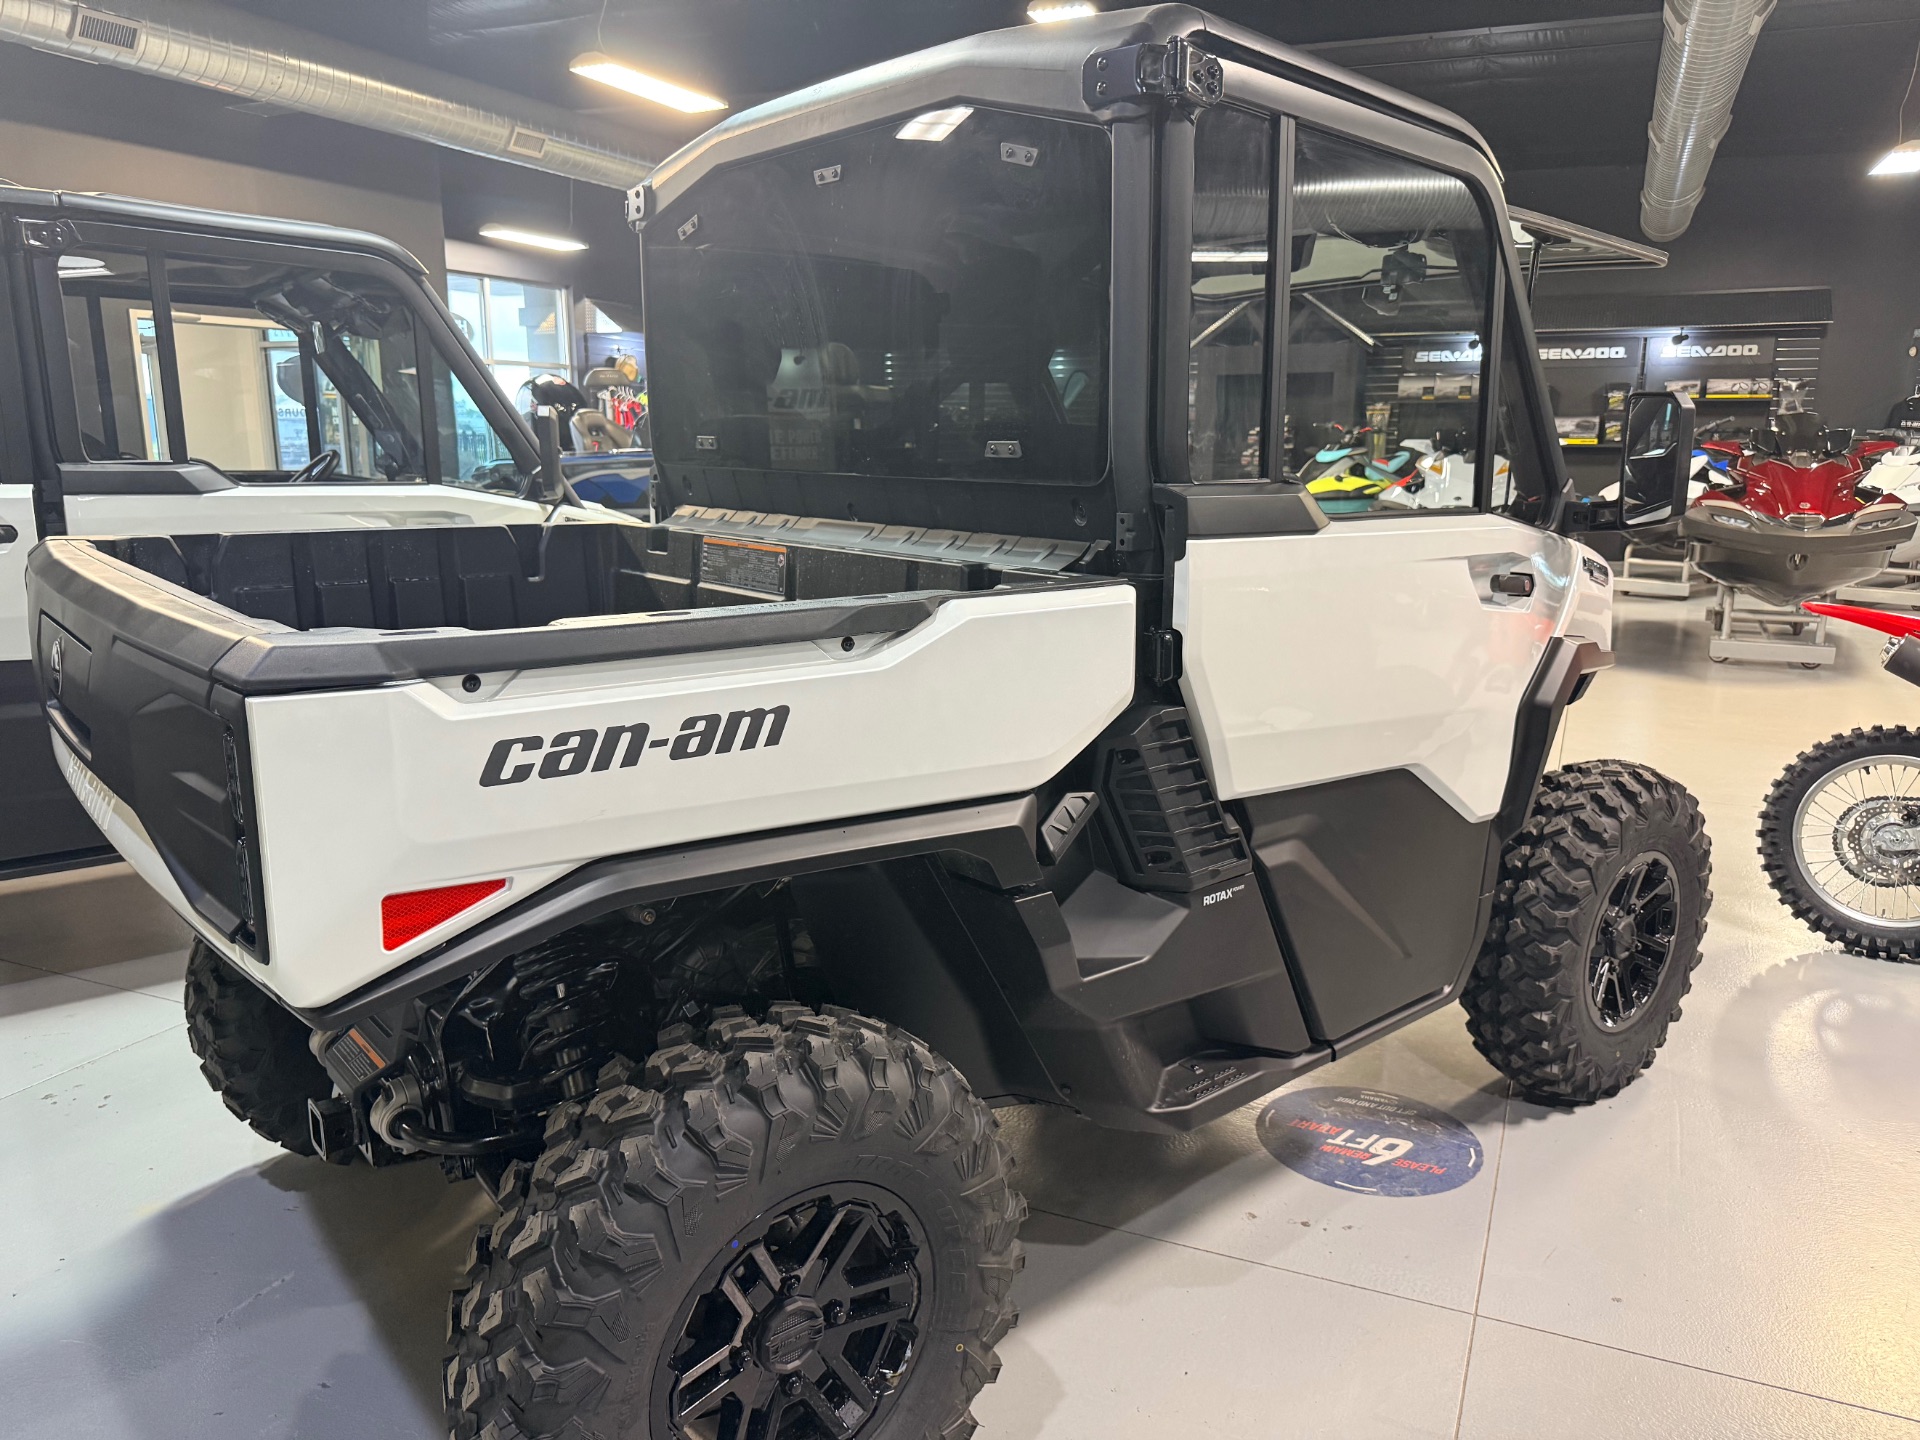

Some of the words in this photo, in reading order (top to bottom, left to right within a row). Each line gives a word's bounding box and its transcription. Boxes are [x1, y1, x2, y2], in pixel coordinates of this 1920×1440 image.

[478, 704, 791, 788] can-am
[1203, 887, 1233, 907] ROTAX
[1333, 1096, 1359, 1106] RIDE
[1355, 1100, 1379, 1109] AND
[1360, 1094, 1389, 1104] YAMAHA
[1319, 1145, 1373, 1160] REMAIN
[1326, 1129, 1414, 1166] 6FT
[1392, 1158, 1448, 1175] PLEASE
